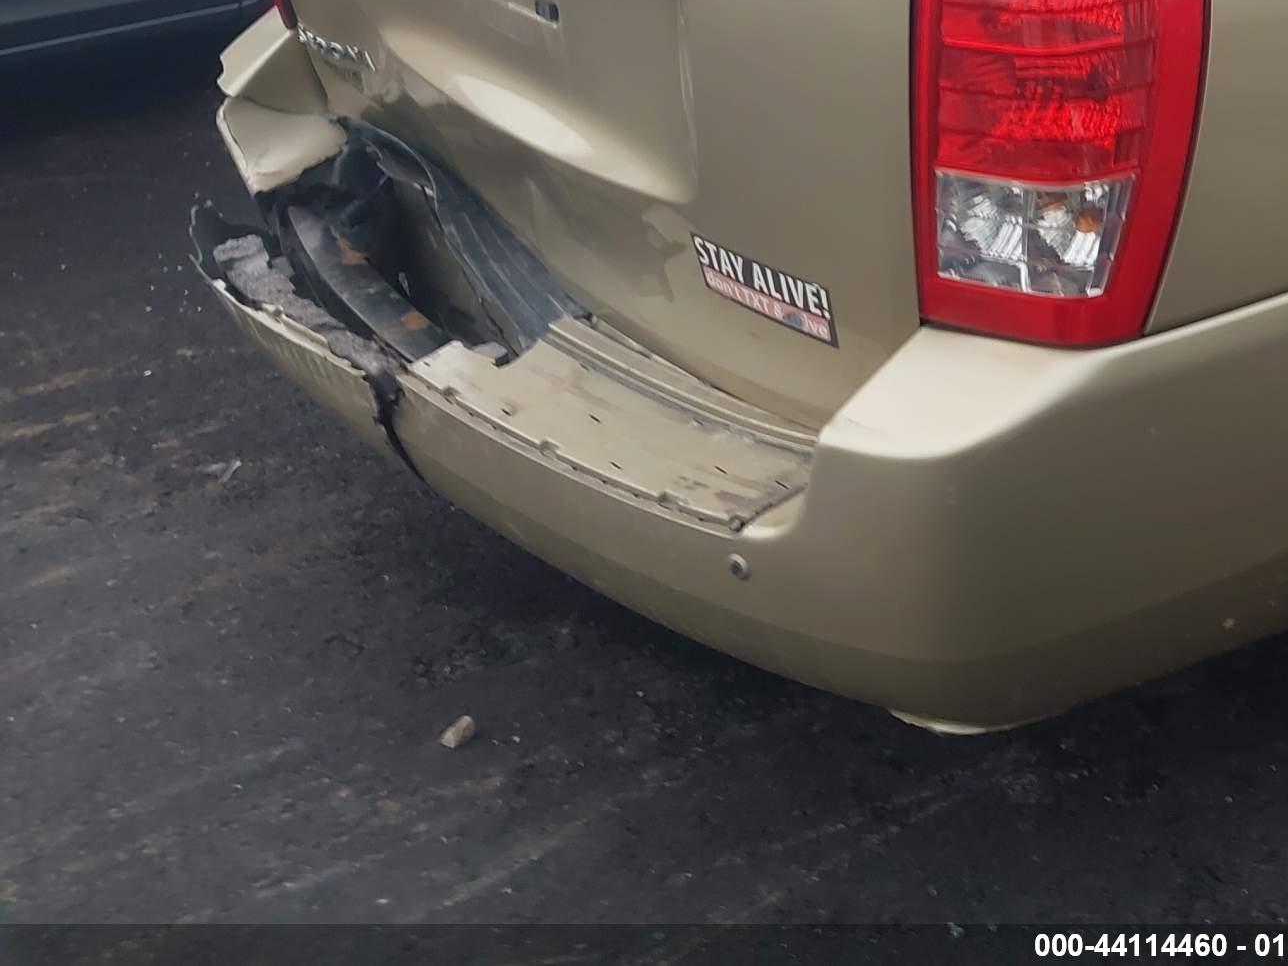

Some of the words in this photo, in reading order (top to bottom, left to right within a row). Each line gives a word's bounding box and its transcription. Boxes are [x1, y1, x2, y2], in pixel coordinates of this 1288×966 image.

[693, 235, 744, 284] STAY
[752, 261, 831, 320] ALIVE!
[741, 285, 770, 315] TXT
